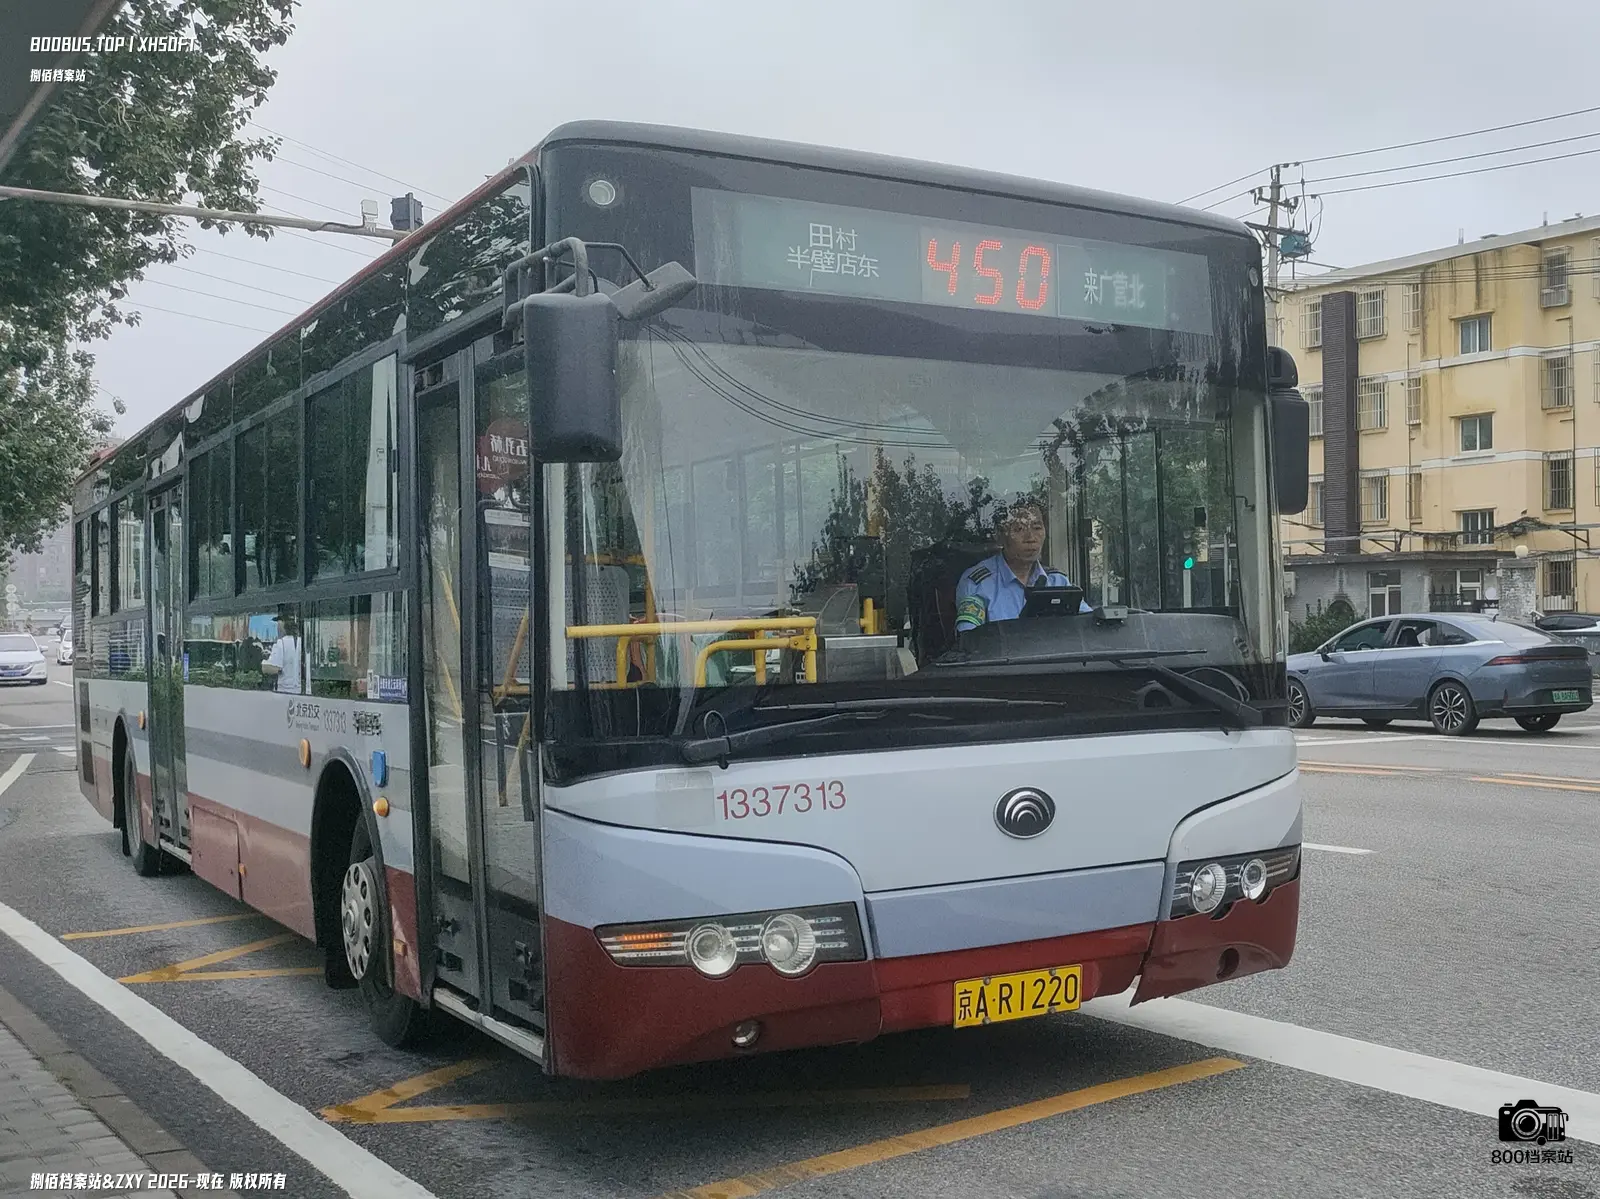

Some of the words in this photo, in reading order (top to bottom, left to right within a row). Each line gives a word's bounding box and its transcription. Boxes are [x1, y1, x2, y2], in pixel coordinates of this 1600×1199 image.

[809, 223, 858, 251] 田村
[787, 245, 880, 278] 半壁店东
[927, 238, 1050, 310] 450
[1084, 267, 1145, 309] 来广营北
[716, 780, 847, 821] 1337313
